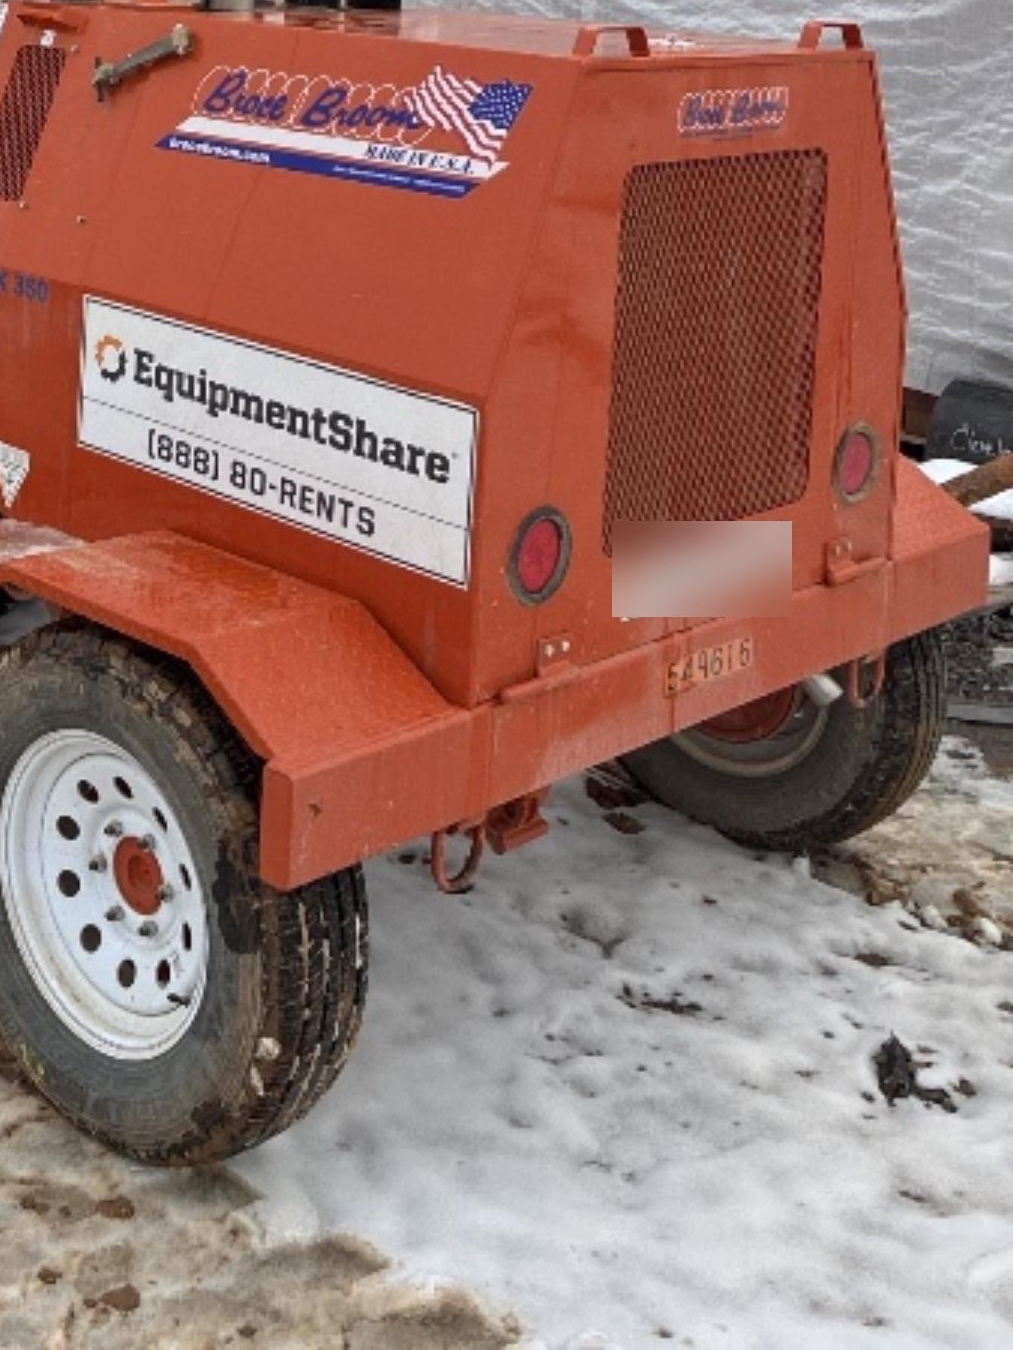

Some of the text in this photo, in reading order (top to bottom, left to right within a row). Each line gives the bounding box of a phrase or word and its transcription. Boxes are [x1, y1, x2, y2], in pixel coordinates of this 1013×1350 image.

[301, 86, 422, 129] Broom
[132, 347, 451, 485] EquipmentShare
[147, 428, 376, 538] (888) 80-RENTS
